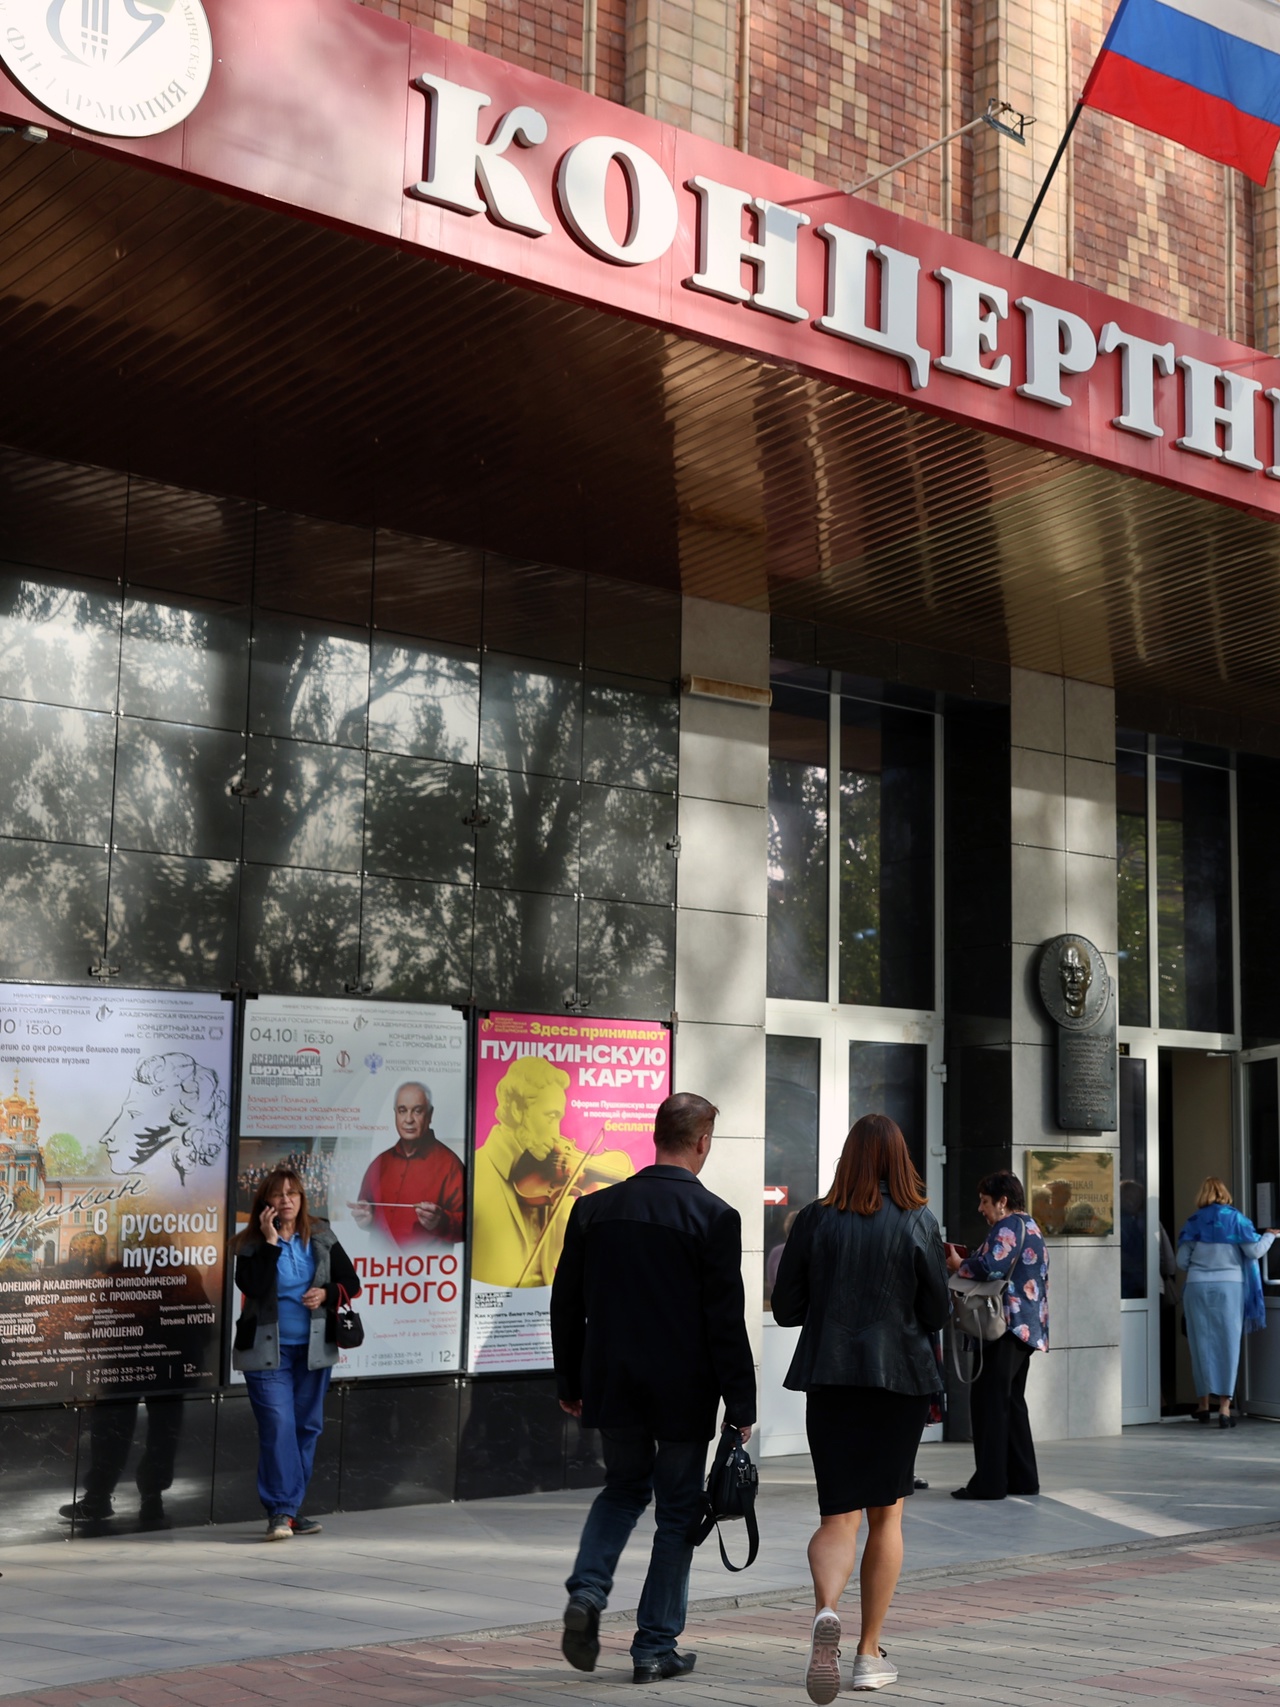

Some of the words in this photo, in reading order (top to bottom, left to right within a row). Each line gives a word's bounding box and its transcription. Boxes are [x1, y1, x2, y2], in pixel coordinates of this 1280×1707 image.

[26, 1024, 62, 1036] 15:00
[137, 1023, 189, 1033] КОНЦЕРТНЫЙ
[250, 1027, 293, 1043] 04.10
[530, 1022, 579, 1038] Здесь
[580, 1027, 667, 1042] принимают
[153, 1032, 206, 1041] ПРОКОФЬЕВА
[303, 1033, 334, 1045] 16:30
[48, 1046, 84, 1054] рождения
[403, 1041, 447, 1049] ПРОКОФЬЕВА
[480, 1040, 667, 1067] ПУШКИНСКУЮ
[579, 1067, 667, 1091] КАРТУ
[600, 1099, 645, 1111] Пушкинскую
[121, 1205, 219, 1242] русской
[122, 1244, 218, 1275] музыке
[43, 1277, 114, 1291] АКАДЕМИЧЕСКИЙ
[116, 1274, 188, 1289] СИМФОНИЧЕСКИЙ
[25, 1294, 60, 1306] ОРКЕСТР
[110, 1290, 163, 1302] ПРОКОФЬЕВА
[439, 1350, 456, 1363] 12+
